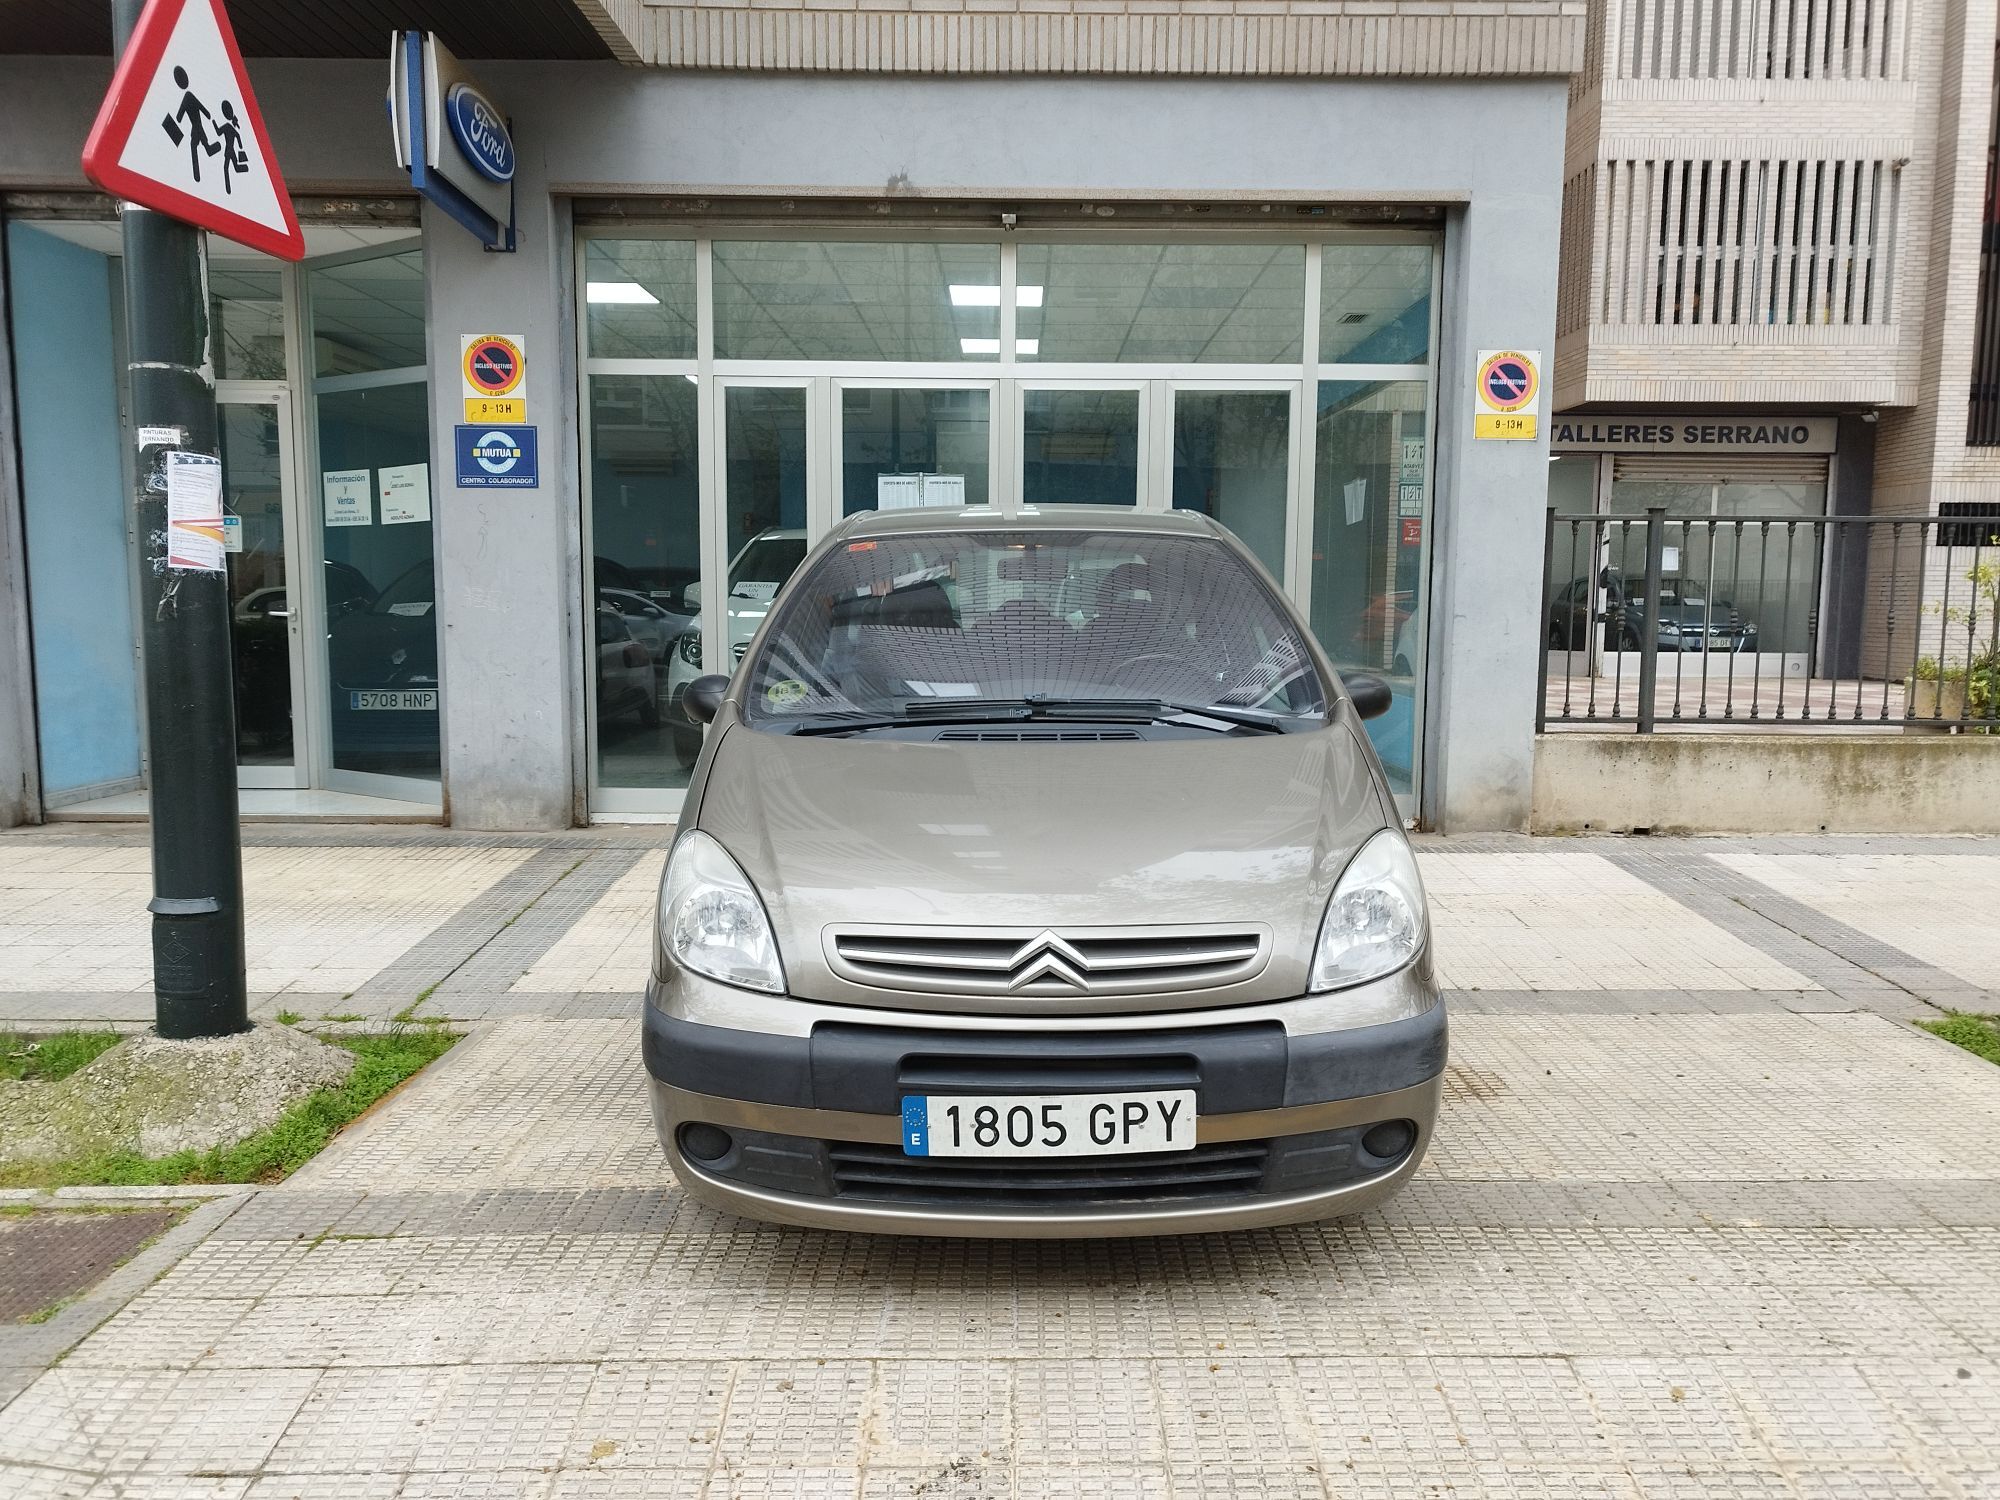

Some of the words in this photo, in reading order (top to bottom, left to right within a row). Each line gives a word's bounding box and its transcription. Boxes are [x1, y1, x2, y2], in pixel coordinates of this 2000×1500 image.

[470, 102, 506, 168] Ford
[1551, 424, 1675, 444] TALLERES
[1683, 425, 1810, 444] SERRANO
[481, 448, 512, 458] MUTUA
[326, 474, 366, 484] Información
[336, 496, 356, 505] Ventas
[361, 693, 398, 707] 5708
[403, 693, 432, 707] HNP
[911, 1133, 921, 1146] E
[946, 1104, 1068, 1148] 1805
[1089, 1099, 1182, 1146] GPY
